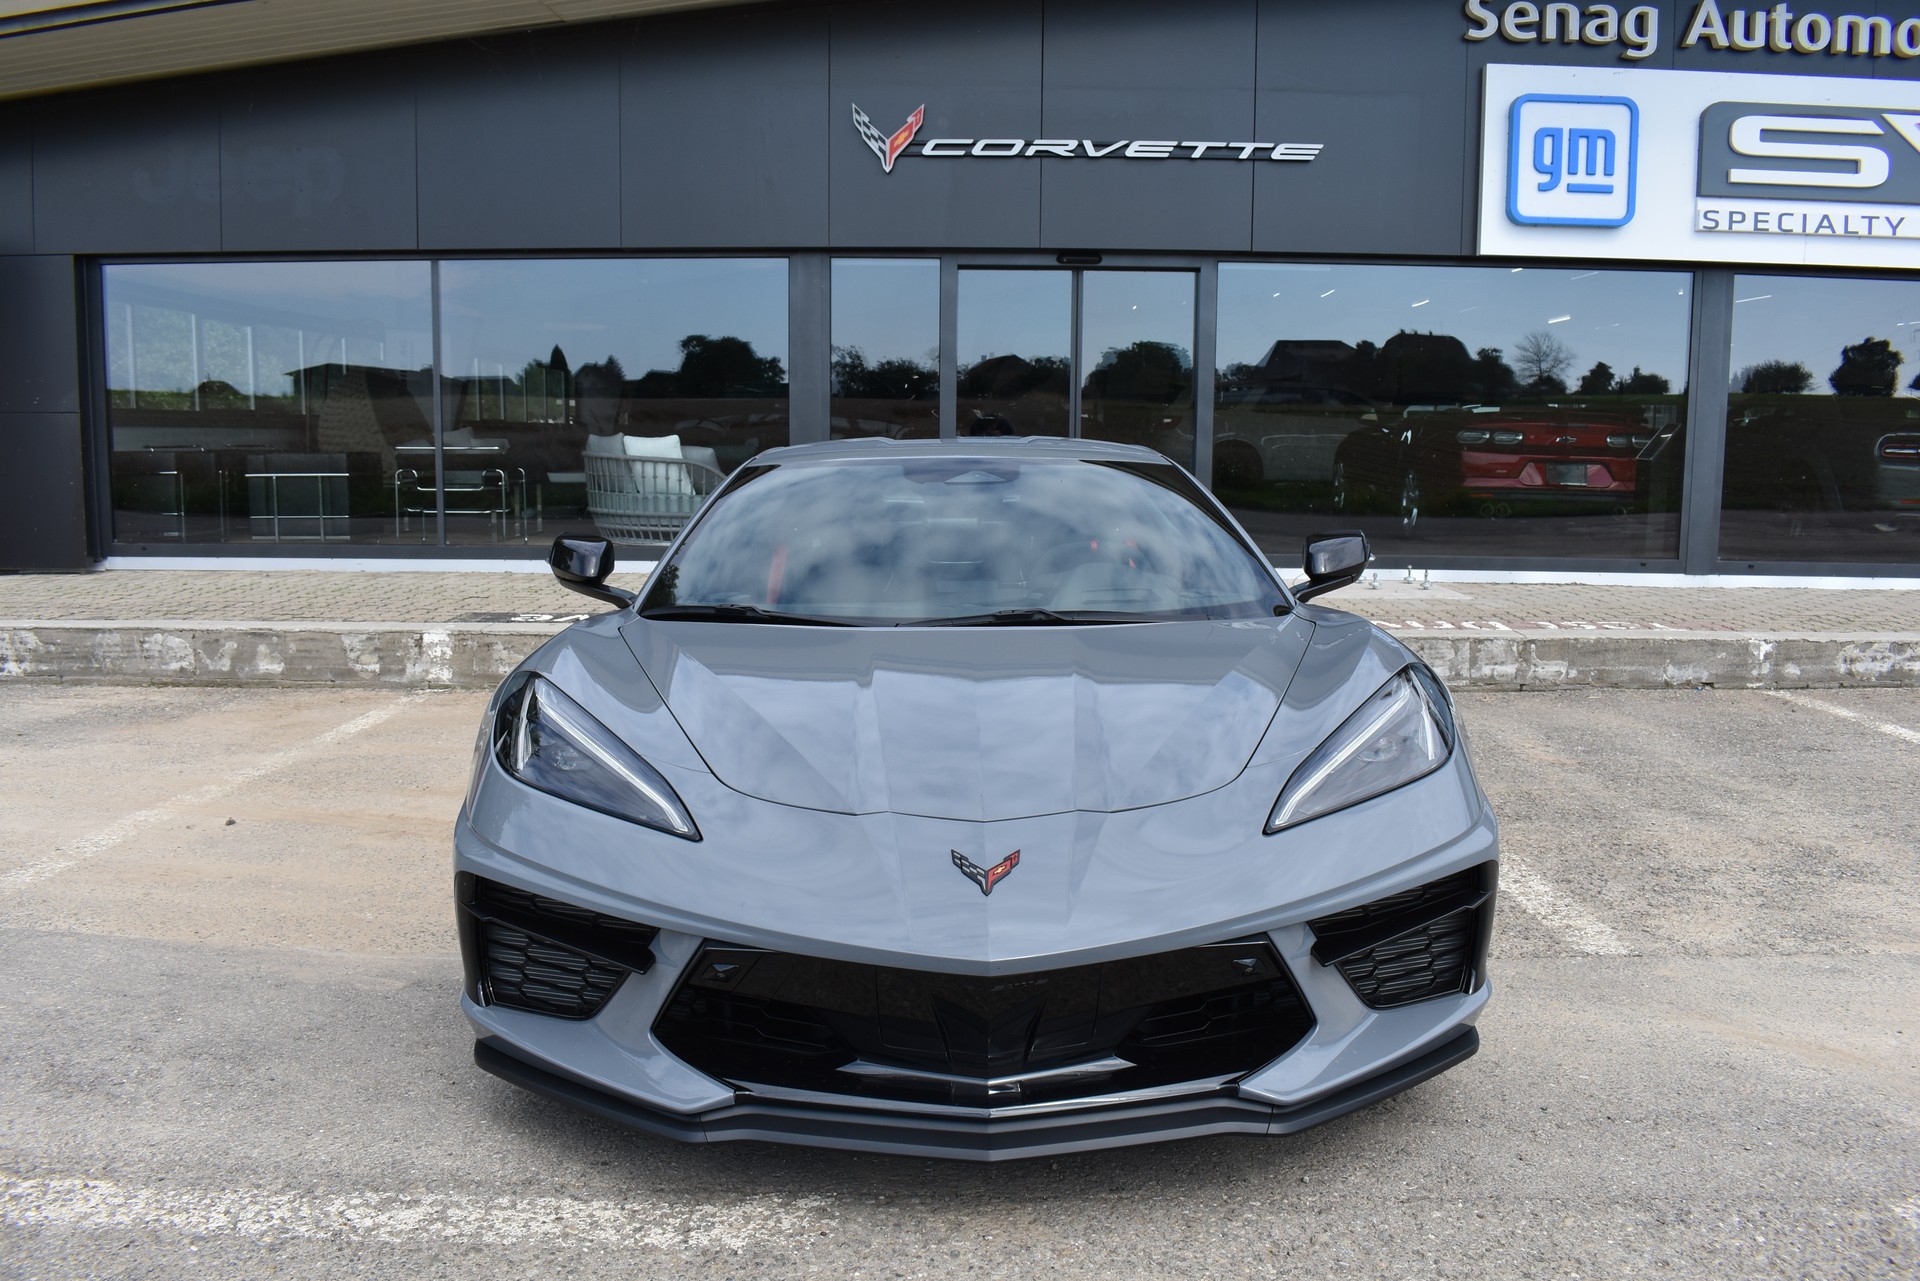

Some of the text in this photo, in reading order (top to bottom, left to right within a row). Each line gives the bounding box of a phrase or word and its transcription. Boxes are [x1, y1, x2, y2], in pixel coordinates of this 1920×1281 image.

[1464, 0, 1658, 58] Senag
[921, 137, 1325, 161] CORVETTE
[1533, 126, 1616, 194] gm
[1702, 209, 1906, 237] SPECIALTY
